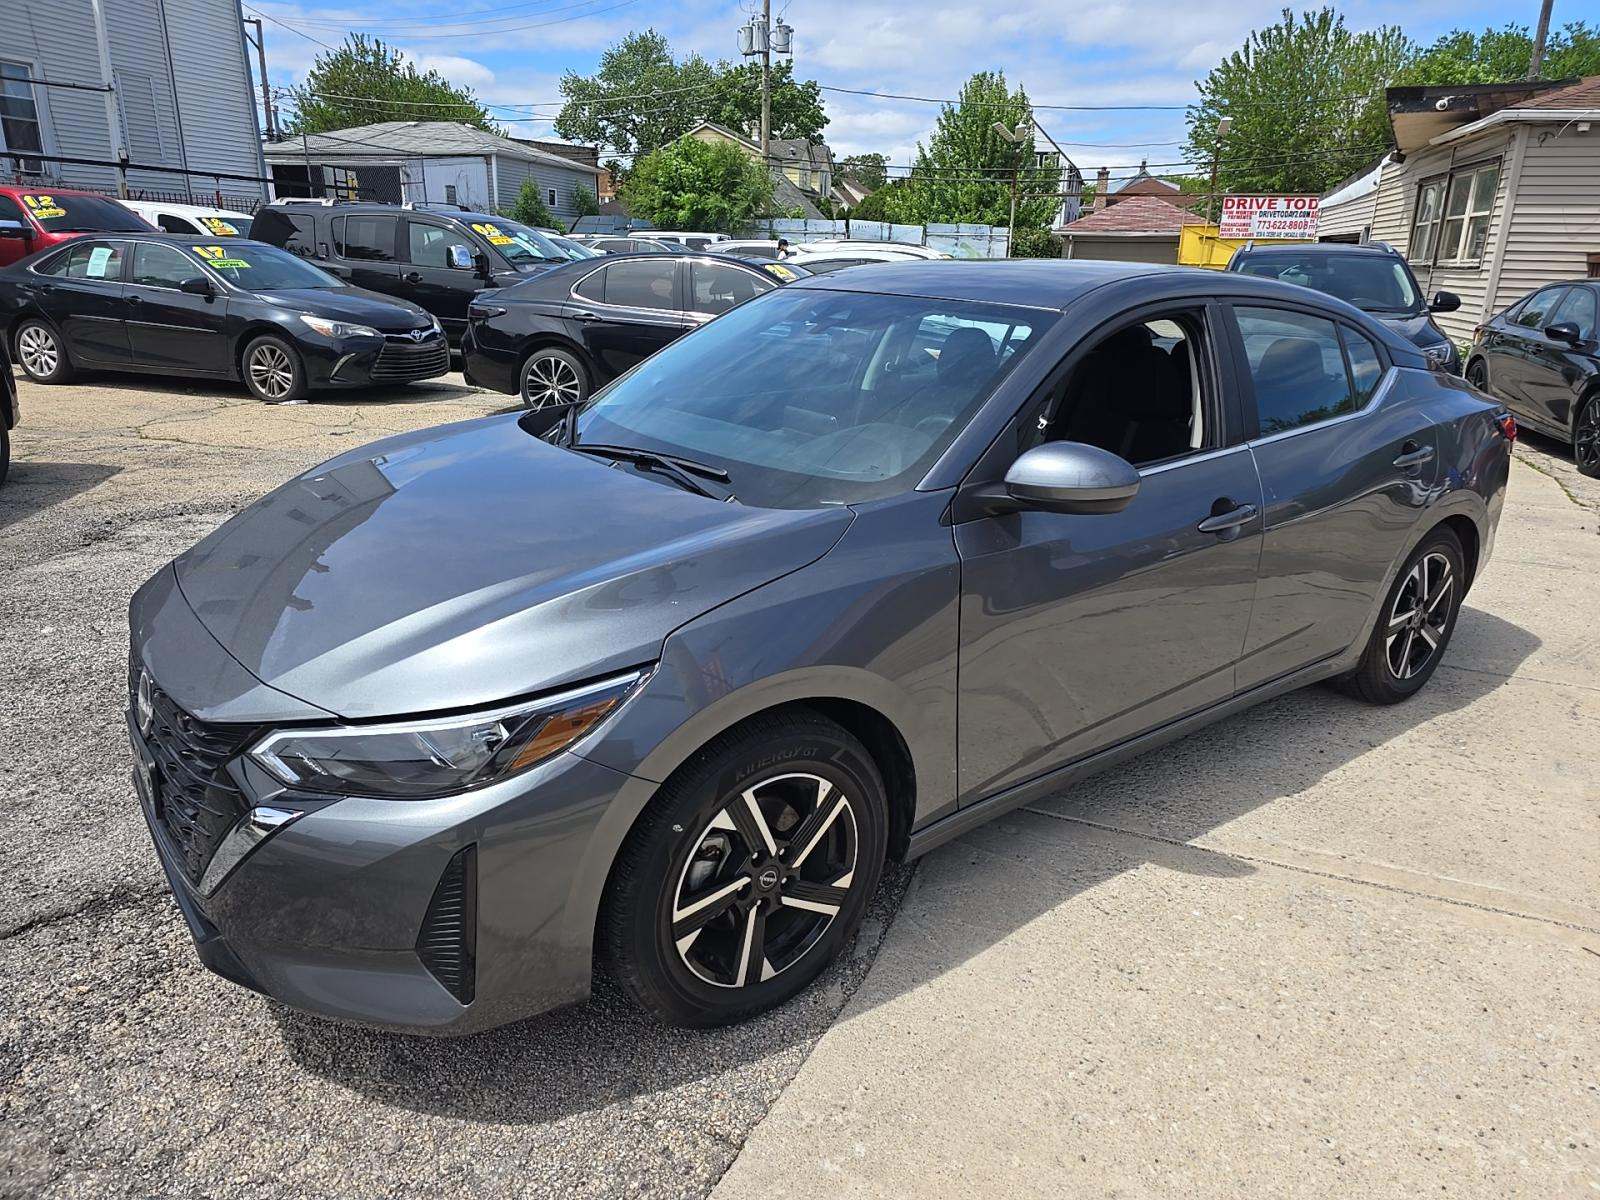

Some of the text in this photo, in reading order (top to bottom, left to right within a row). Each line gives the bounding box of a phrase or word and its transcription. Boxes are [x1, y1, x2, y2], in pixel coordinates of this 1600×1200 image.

[1224, 198, 1318, 210] DRIVE TOD
[1257, 220, 1309, 230] 773-622-8808
[192, 246, 227, 259] 17
